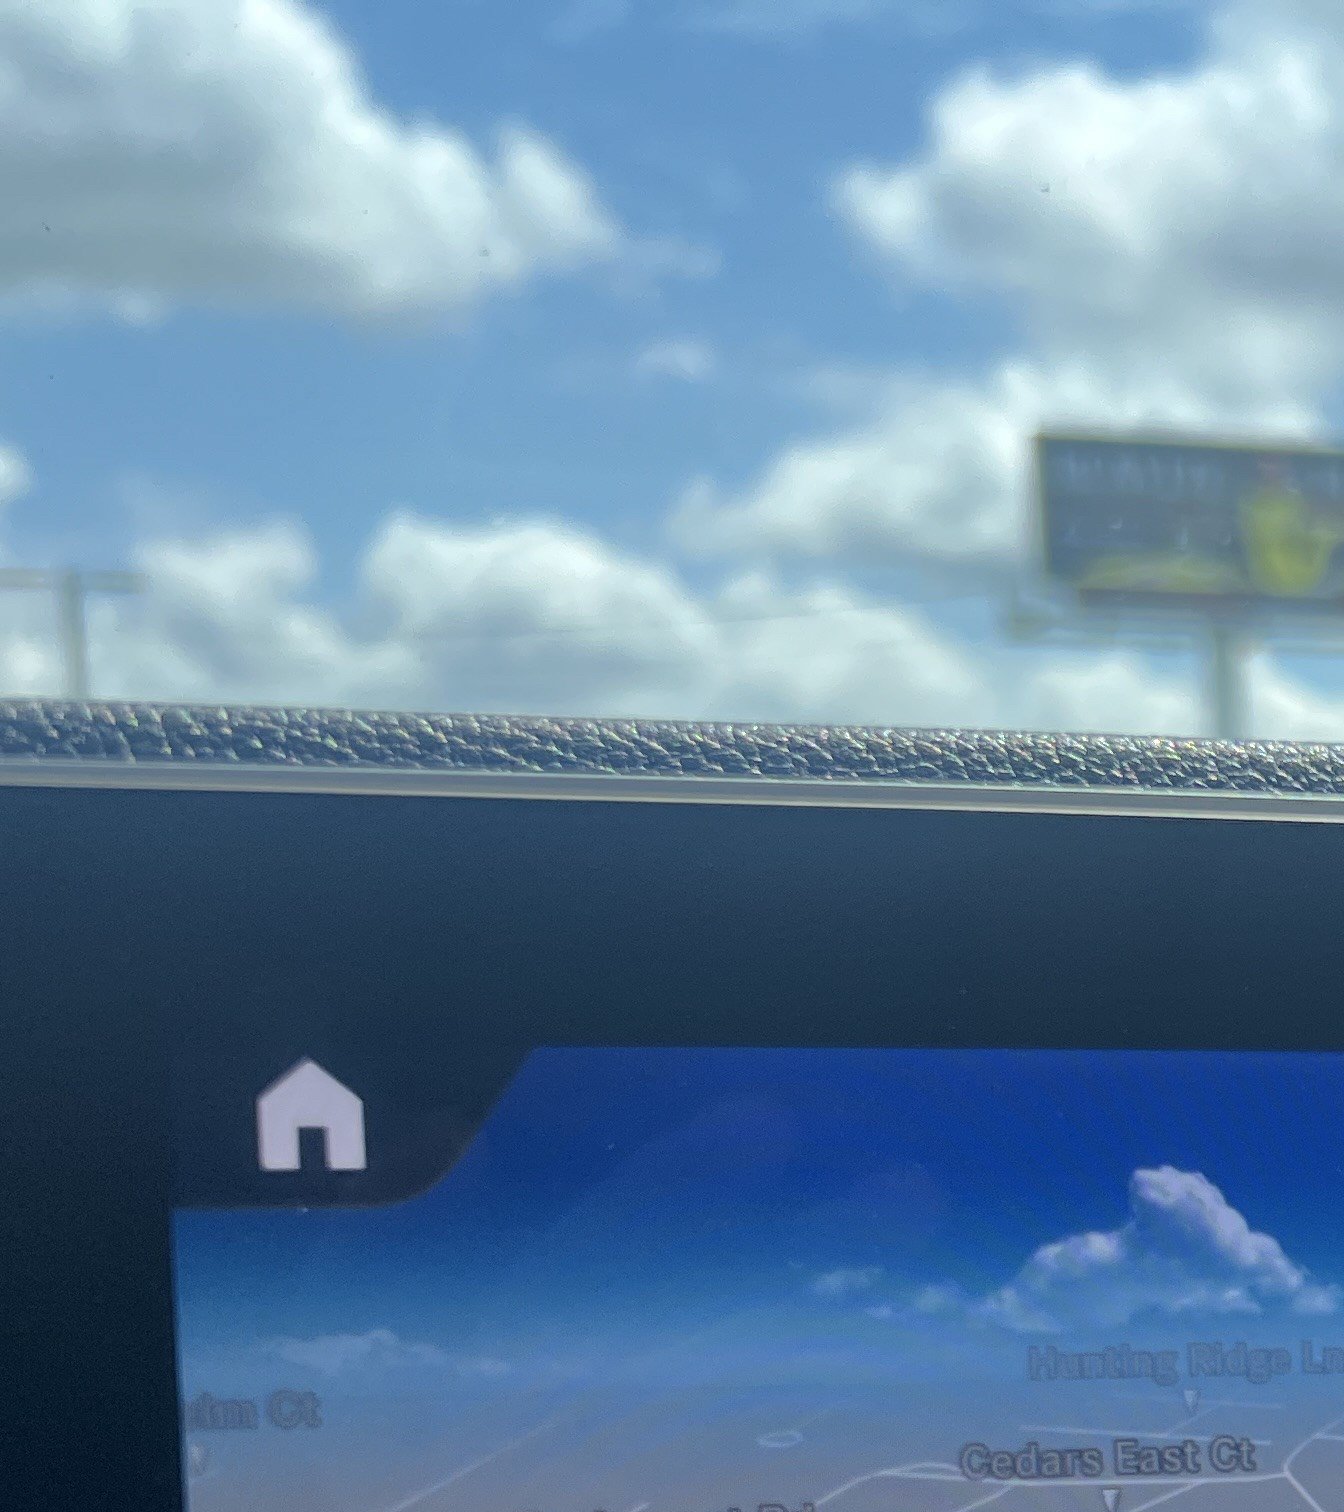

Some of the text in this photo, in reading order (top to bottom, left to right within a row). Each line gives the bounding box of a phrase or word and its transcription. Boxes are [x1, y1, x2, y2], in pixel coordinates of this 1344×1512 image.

[1027, 1343, 1178, 1386] Hunting
[1187, 1341, 1290, 1385] Ridge
[267, 1388, 322, 1430] Ct
[959, 1435, 1258, 1480] Cedars East Ct
